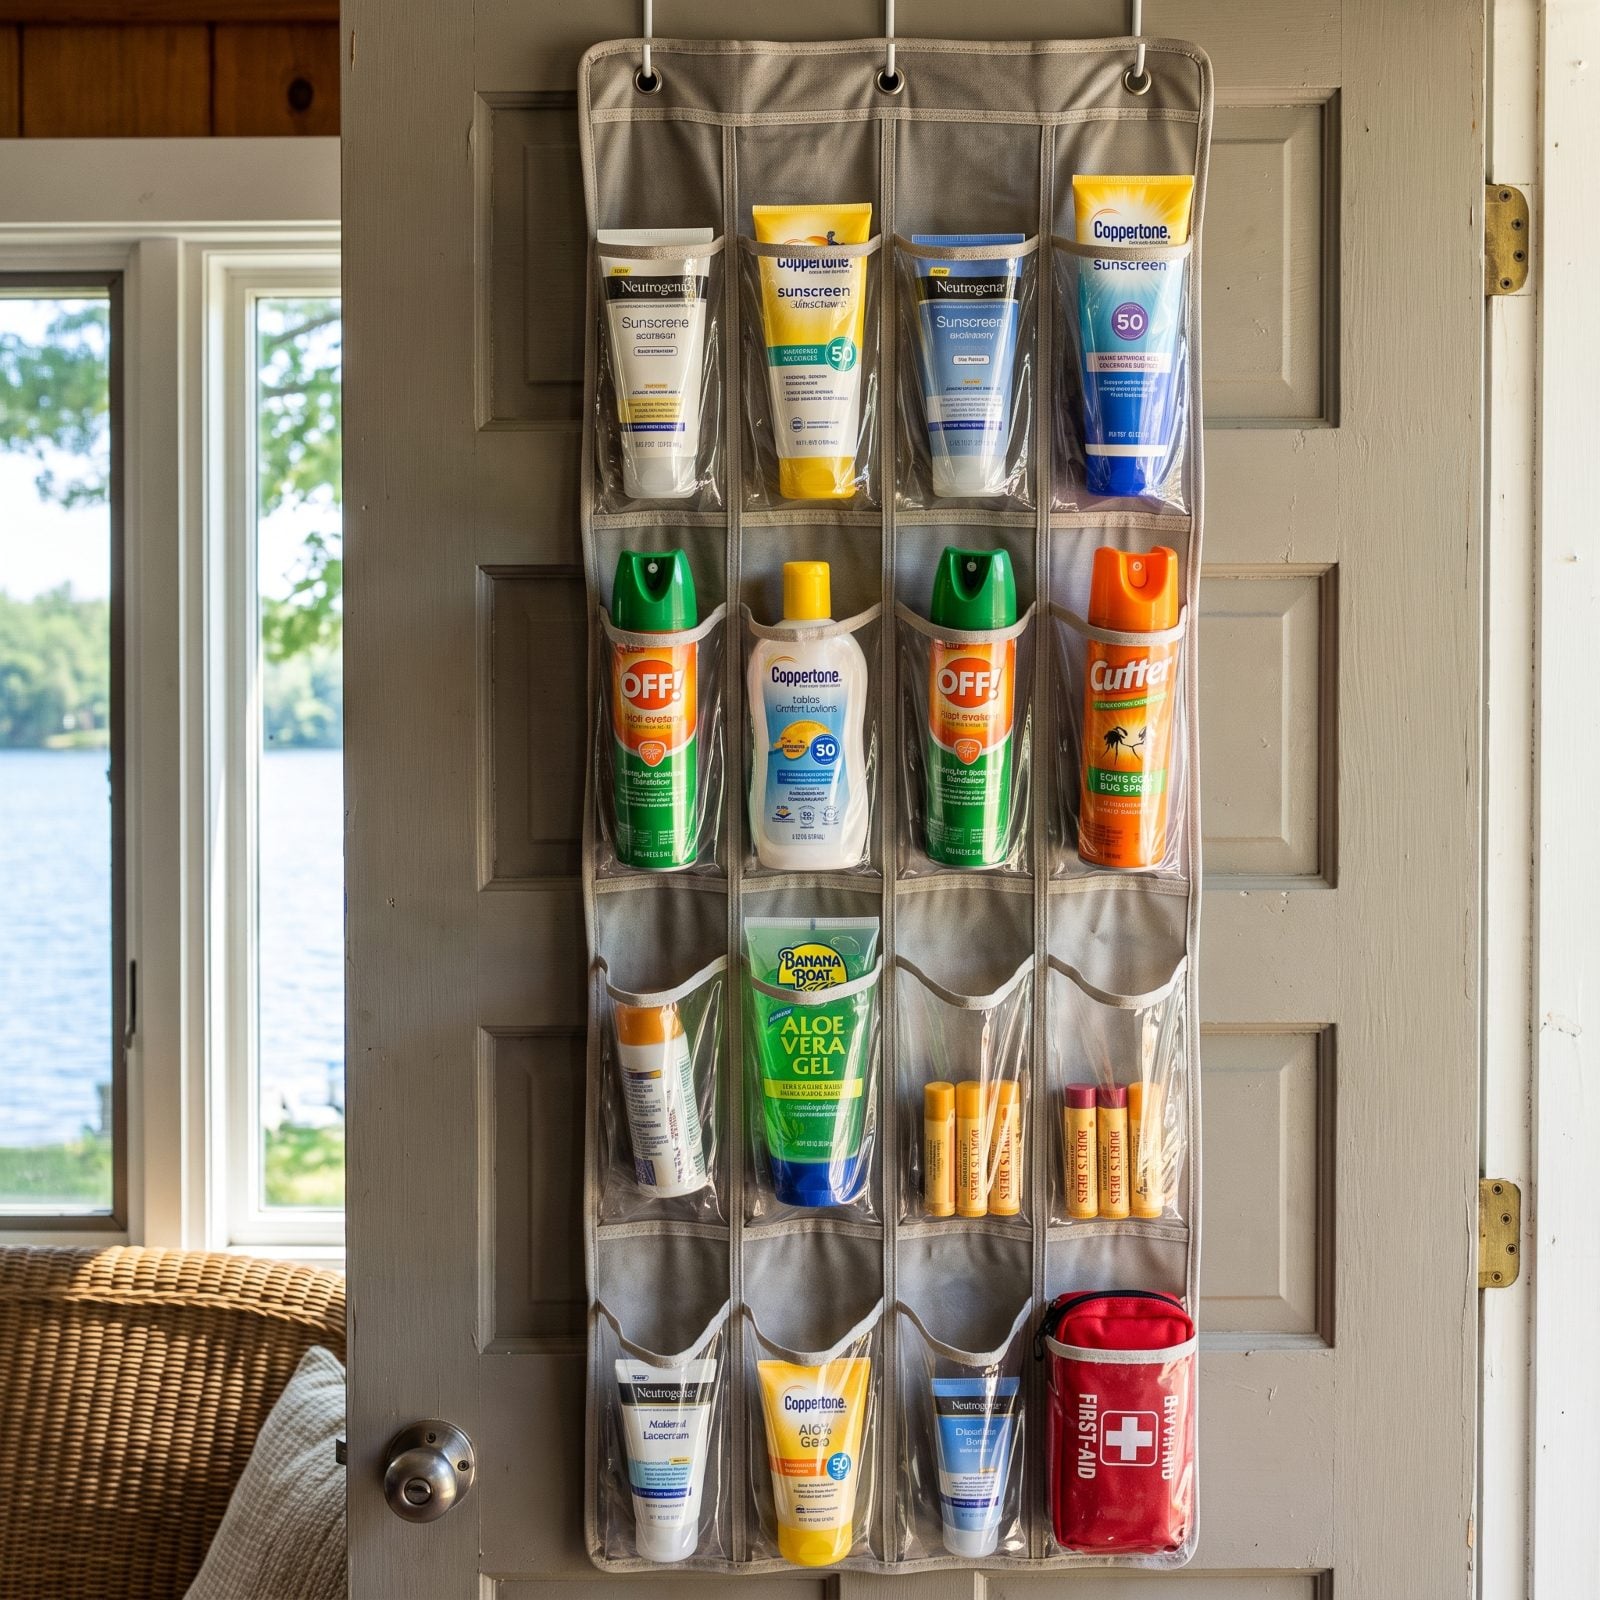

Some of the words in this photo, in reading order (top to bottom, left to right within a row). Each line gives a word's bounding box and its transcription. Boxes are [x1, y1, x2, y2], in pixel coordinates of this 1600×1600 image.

[1093, 259, 1167, 271] Sunscreen
[777, 287, 851, 298] sunscreen
[936, 281, 1005, 296] Neutrogena
[1117, 313, 1143, 331] 50
[831, 345, 853, 362] 50
[1090, 656, 1173, 691] Cutter
[621, 669, 684, 701] OFF!
[937, 667, 1002, 700] OFF!
[1100, 782, 1120, 792] BUG
[781, 951, 842, 970] BANANA
[792, 969, 833, 989] BOAT
[780, 1015, 845, 1035] ALOE
[780, 1037, 846, 1055] VERA
[792, 1057, 835, 1075] GEL
[1077, 1393, 1098, 1479] FIRST-AID
[832, 1457, 848, 1471] 50
